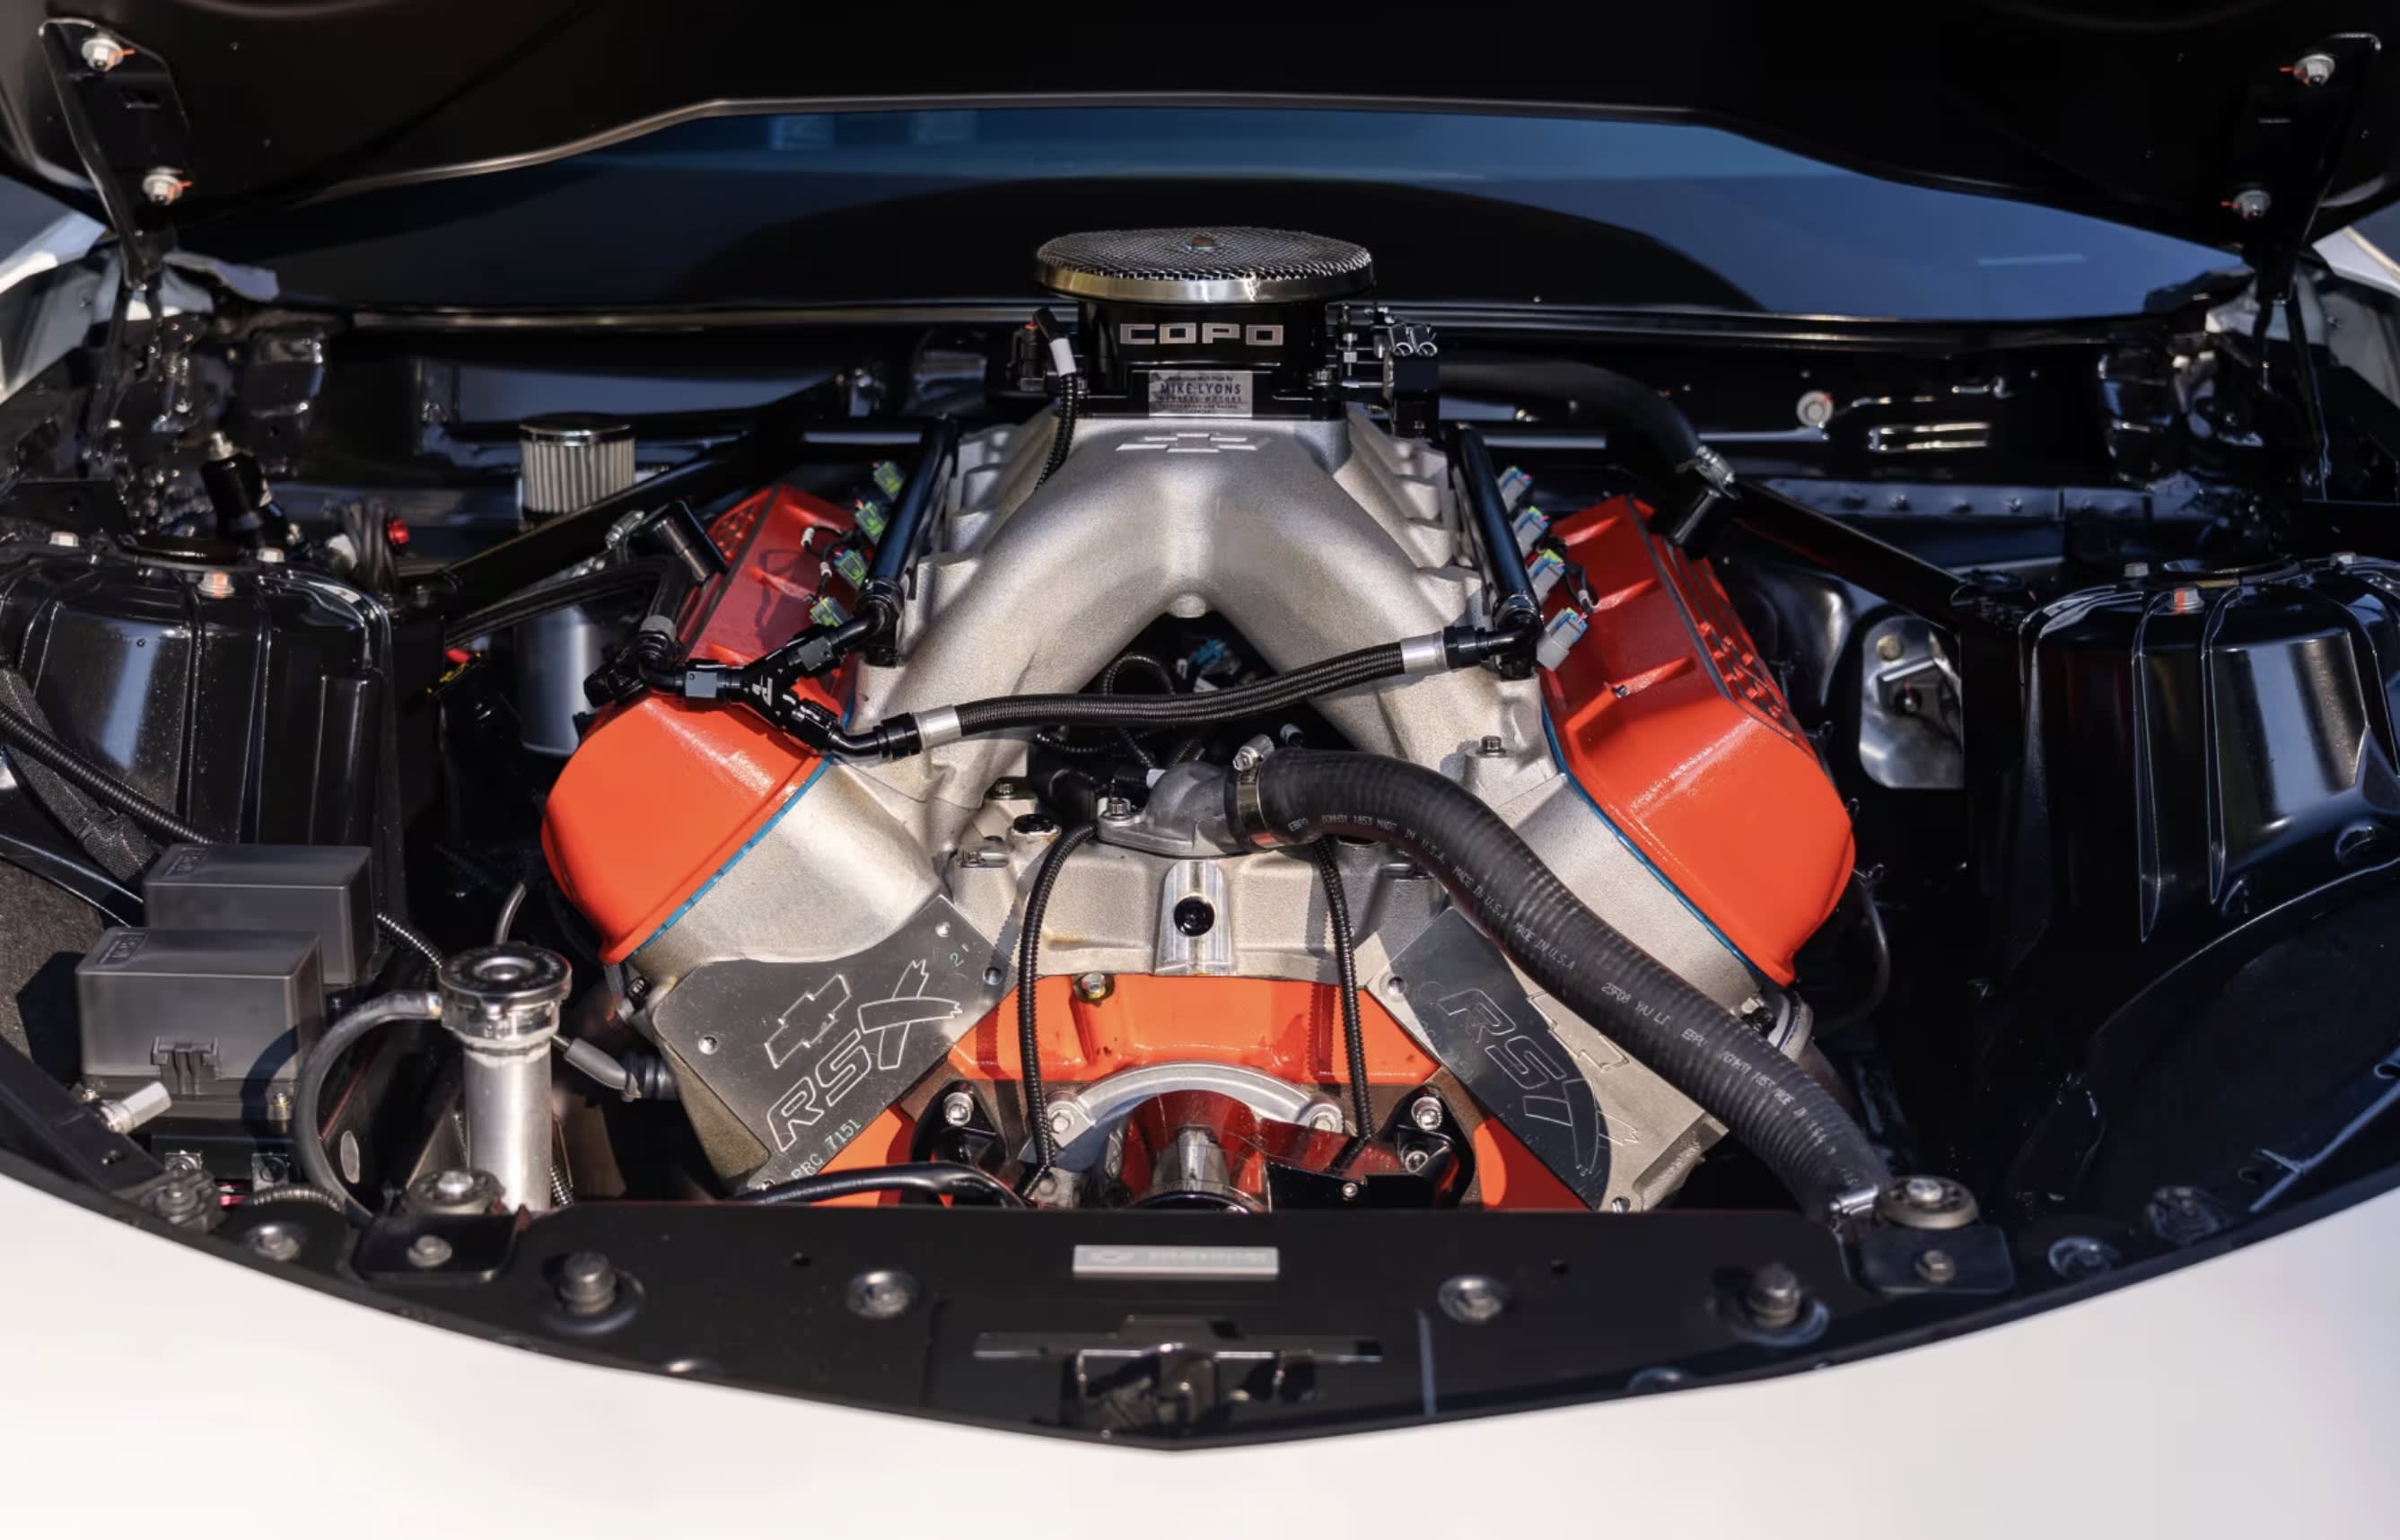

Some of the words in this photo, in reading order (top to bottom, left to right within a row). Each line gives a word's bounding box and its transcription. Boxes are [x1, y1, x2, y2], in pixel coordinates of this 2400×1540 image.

[1119, 322, 1284, 347] COPO
[1161, 382, 1193, 395] MIKE
[1198, 382, 1241, 395] LYONS
[1515, 922, 1537, 942] MADE
[790, 1153, 824, 1180] PRC
[824, 1118, 863, 1151] 7151
